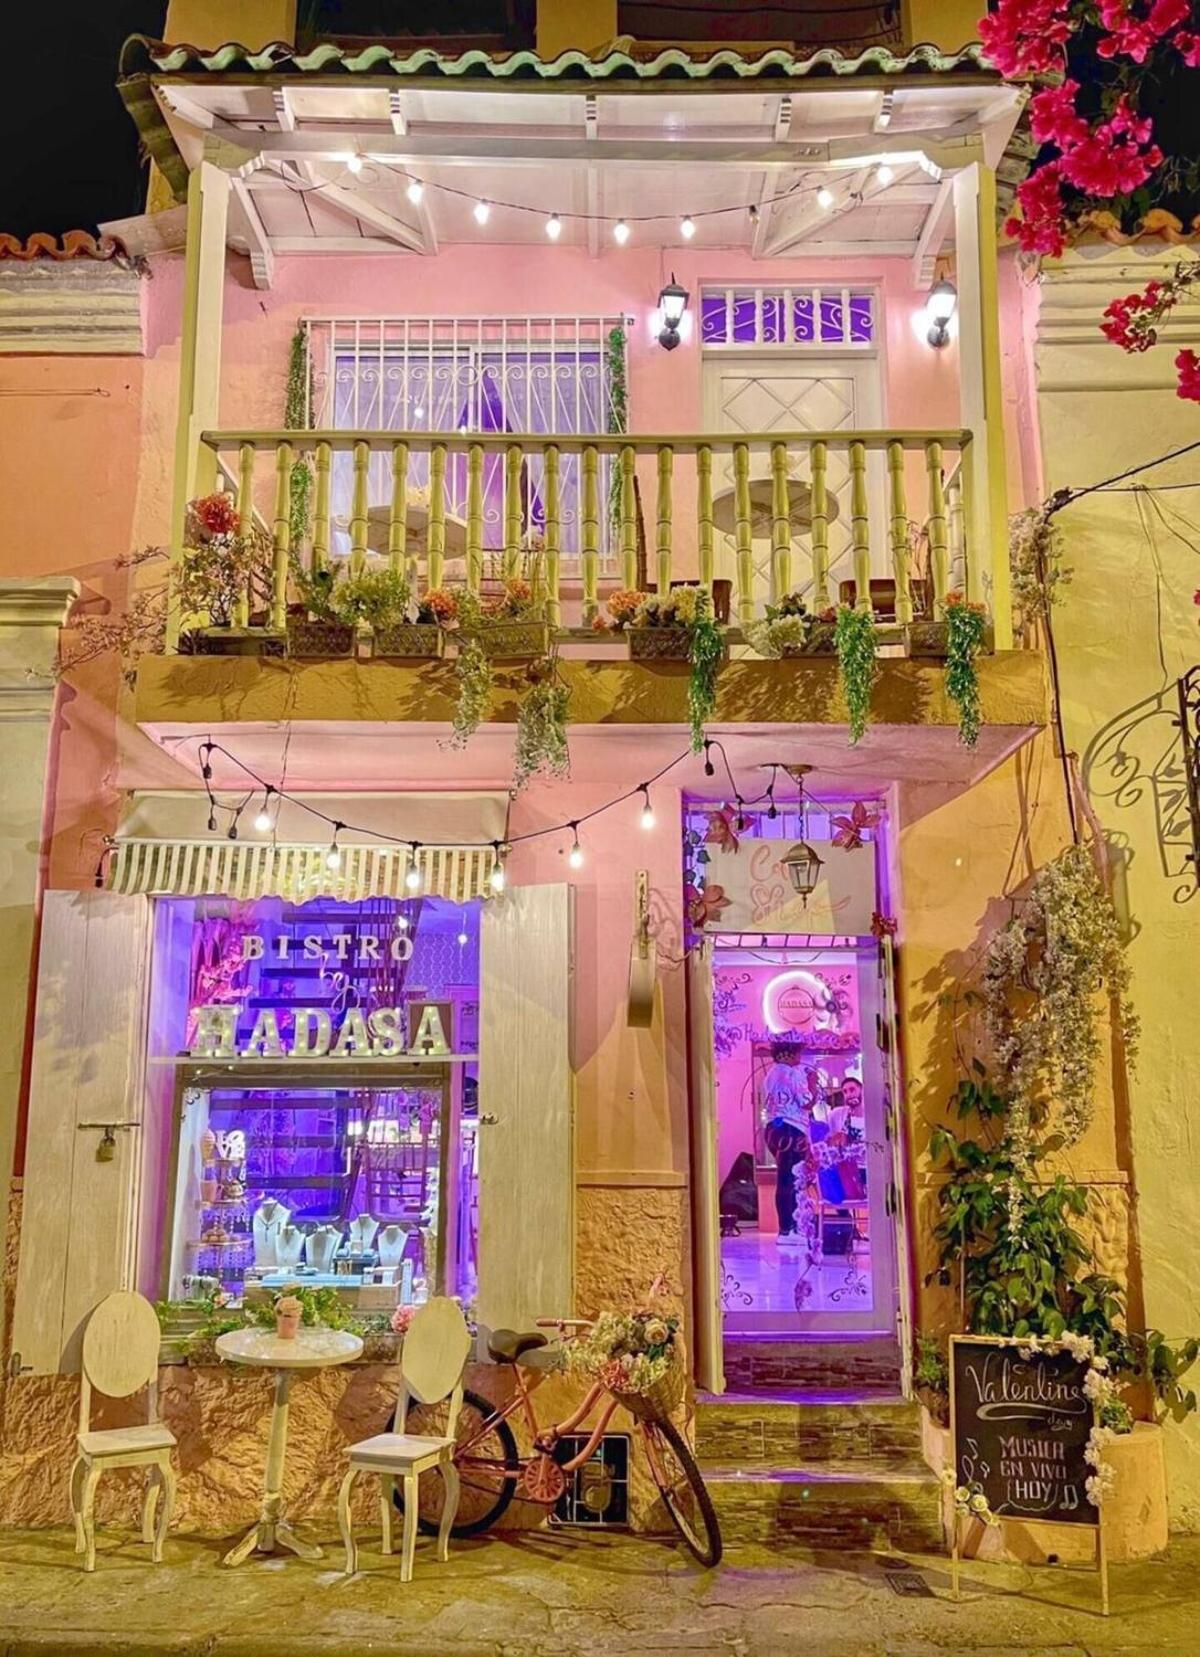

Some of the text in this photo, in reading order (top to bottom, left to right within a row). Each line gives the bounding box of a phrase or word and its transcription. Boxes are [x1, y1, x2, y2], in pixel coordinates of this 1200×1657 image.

[241, 935, 414, 961] BISTRO
[319, 952, 361, 1014] by
[190, 1003, 452, 1058] HADASA
[1000, 1460, 1067, 1480] EN VIVO
[1015, 1479, 1052, 1503] HOY
